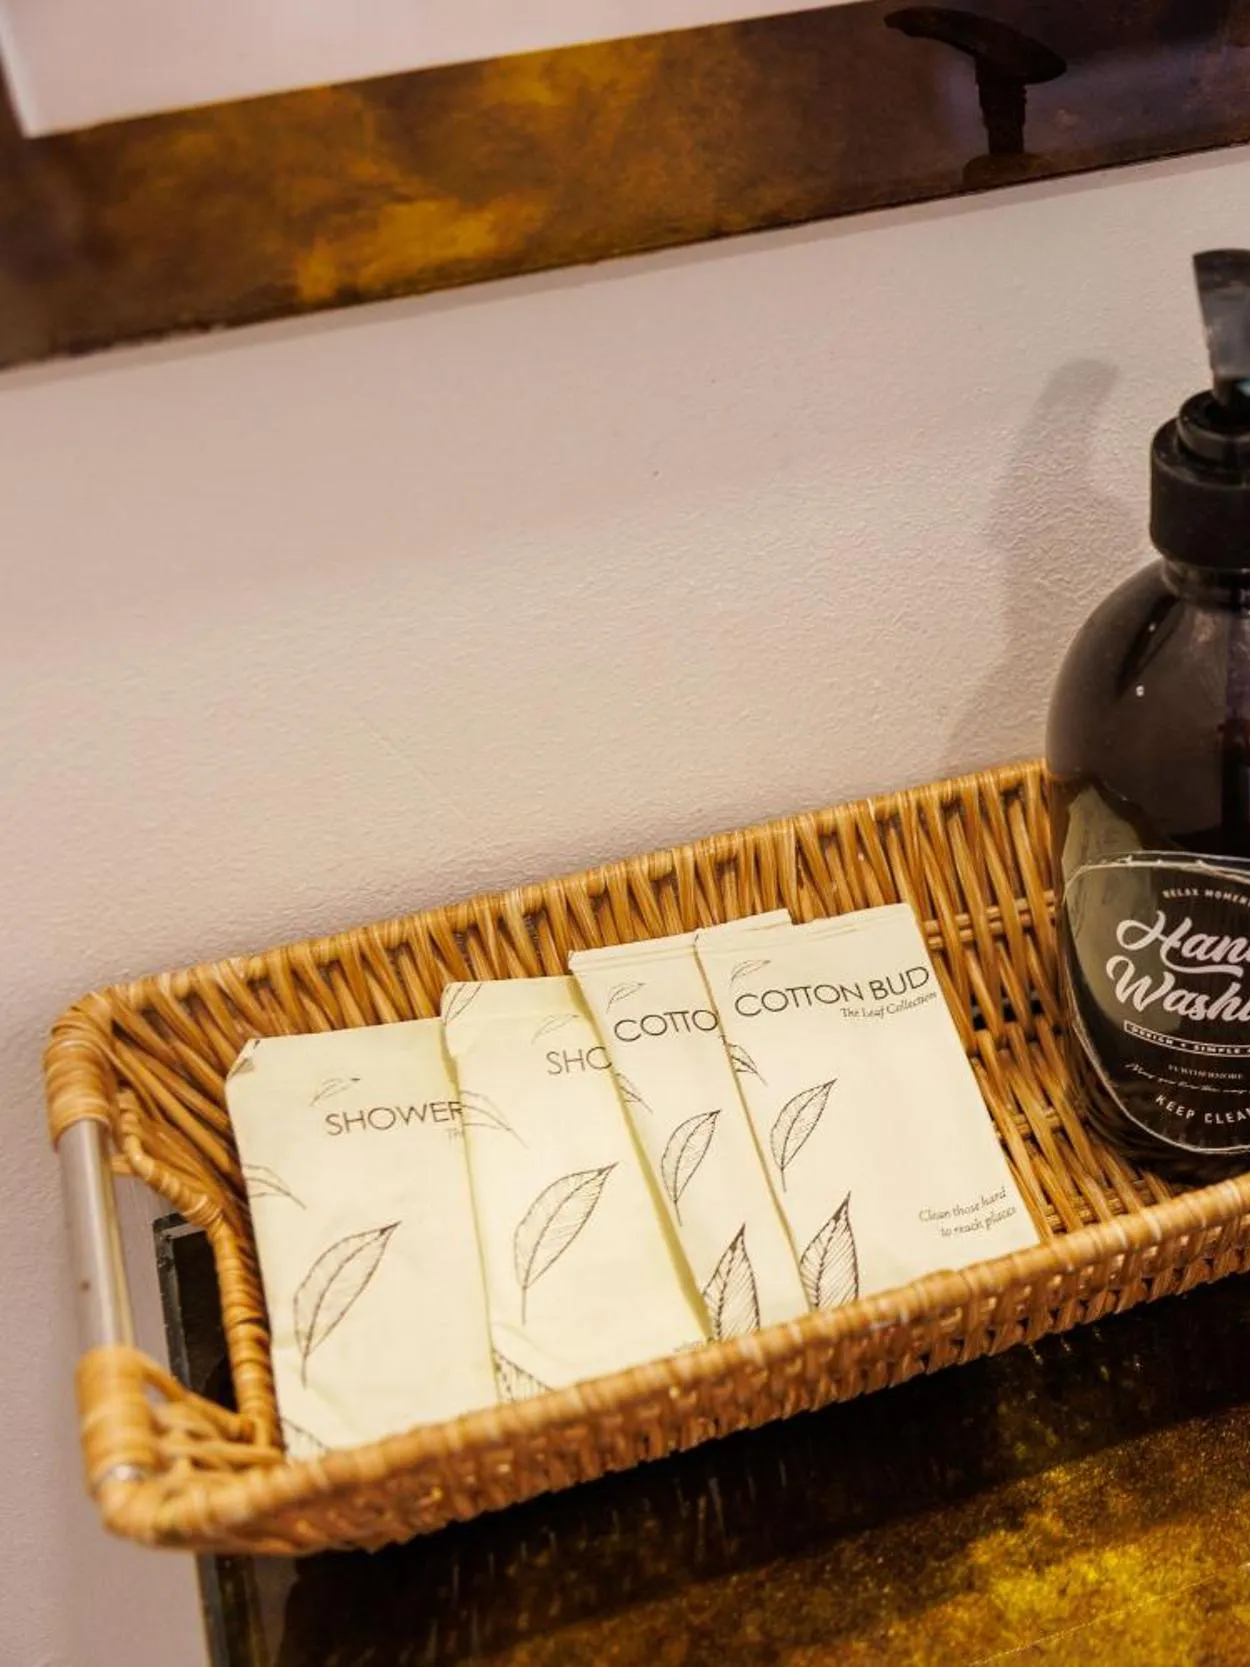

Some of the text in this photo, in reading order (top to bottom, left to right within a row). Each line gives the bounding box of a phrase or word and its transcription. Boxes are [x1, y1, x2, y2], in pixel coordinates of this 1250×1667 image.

[1162, 887, 1199, 899] RELAX
[735, 966, 930, 1017] COTTON BUD
[840, 991, 938, 1019] The Leaf Collection
[1155, 1094, 1196, 1120] KEEP
[918, 1208, 952, 1222] Clean
[952, 1203, 980, 1217] those
[940, 1225, 952, 1237] to
